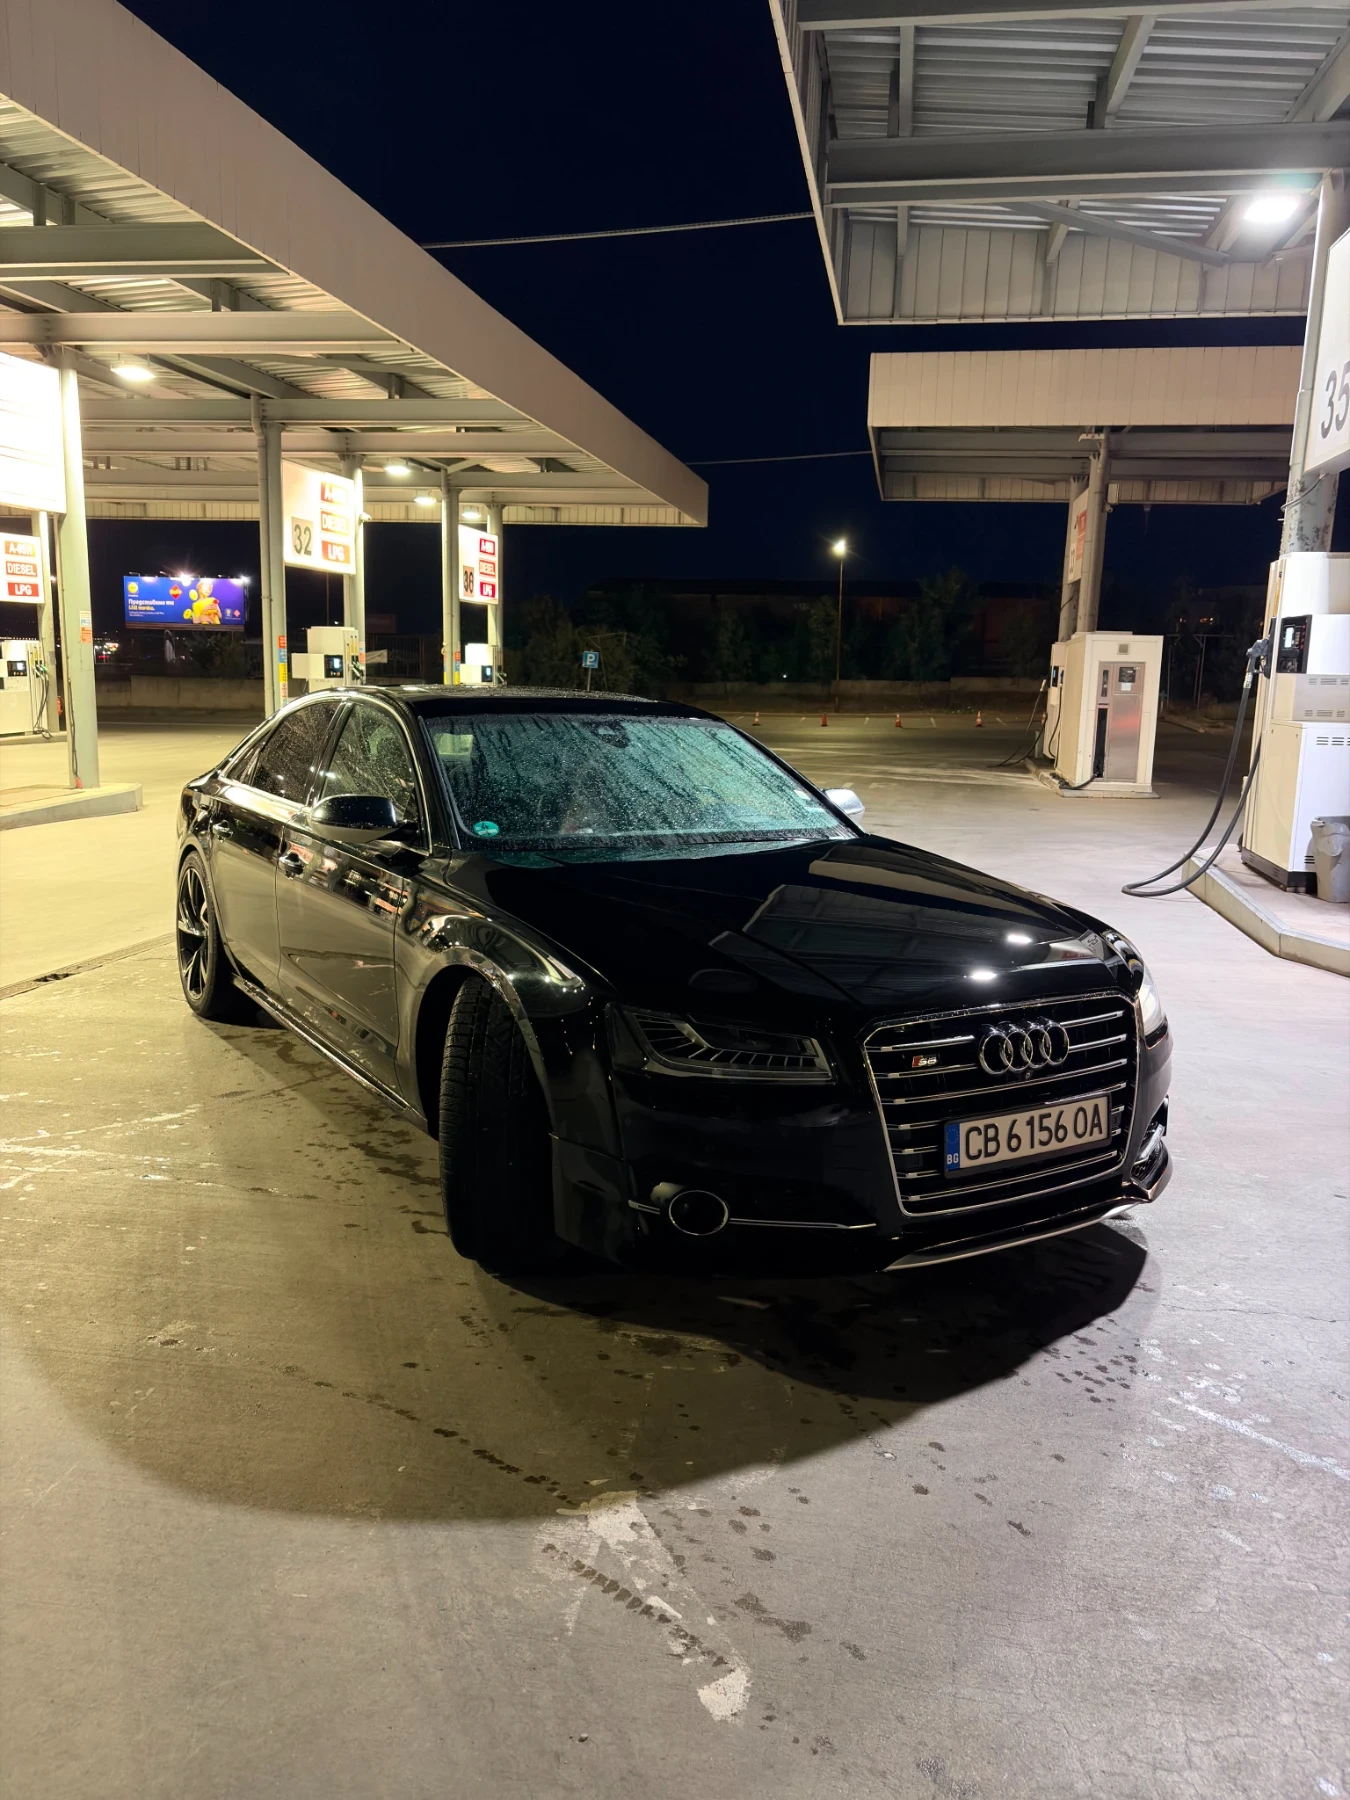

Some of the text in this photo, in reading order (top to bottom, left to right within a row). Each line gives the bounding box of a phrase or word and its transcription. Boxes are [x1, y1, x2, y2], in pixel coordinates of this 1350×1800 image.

[1320, 360, 1350, 439] 35
[294, 524, 312, 556] 32
[328, 544, 345, 561] LPG
[7, 562, 37, 576] DIESEL
[15, 583, 33, 596] LPG
[483, 583, 493, 597] LPG
[586, 653, 596, 665] P
[965, 1103, 1104, 1161] CB 6156 OA
[946, 1153, 959, 1165] BG
